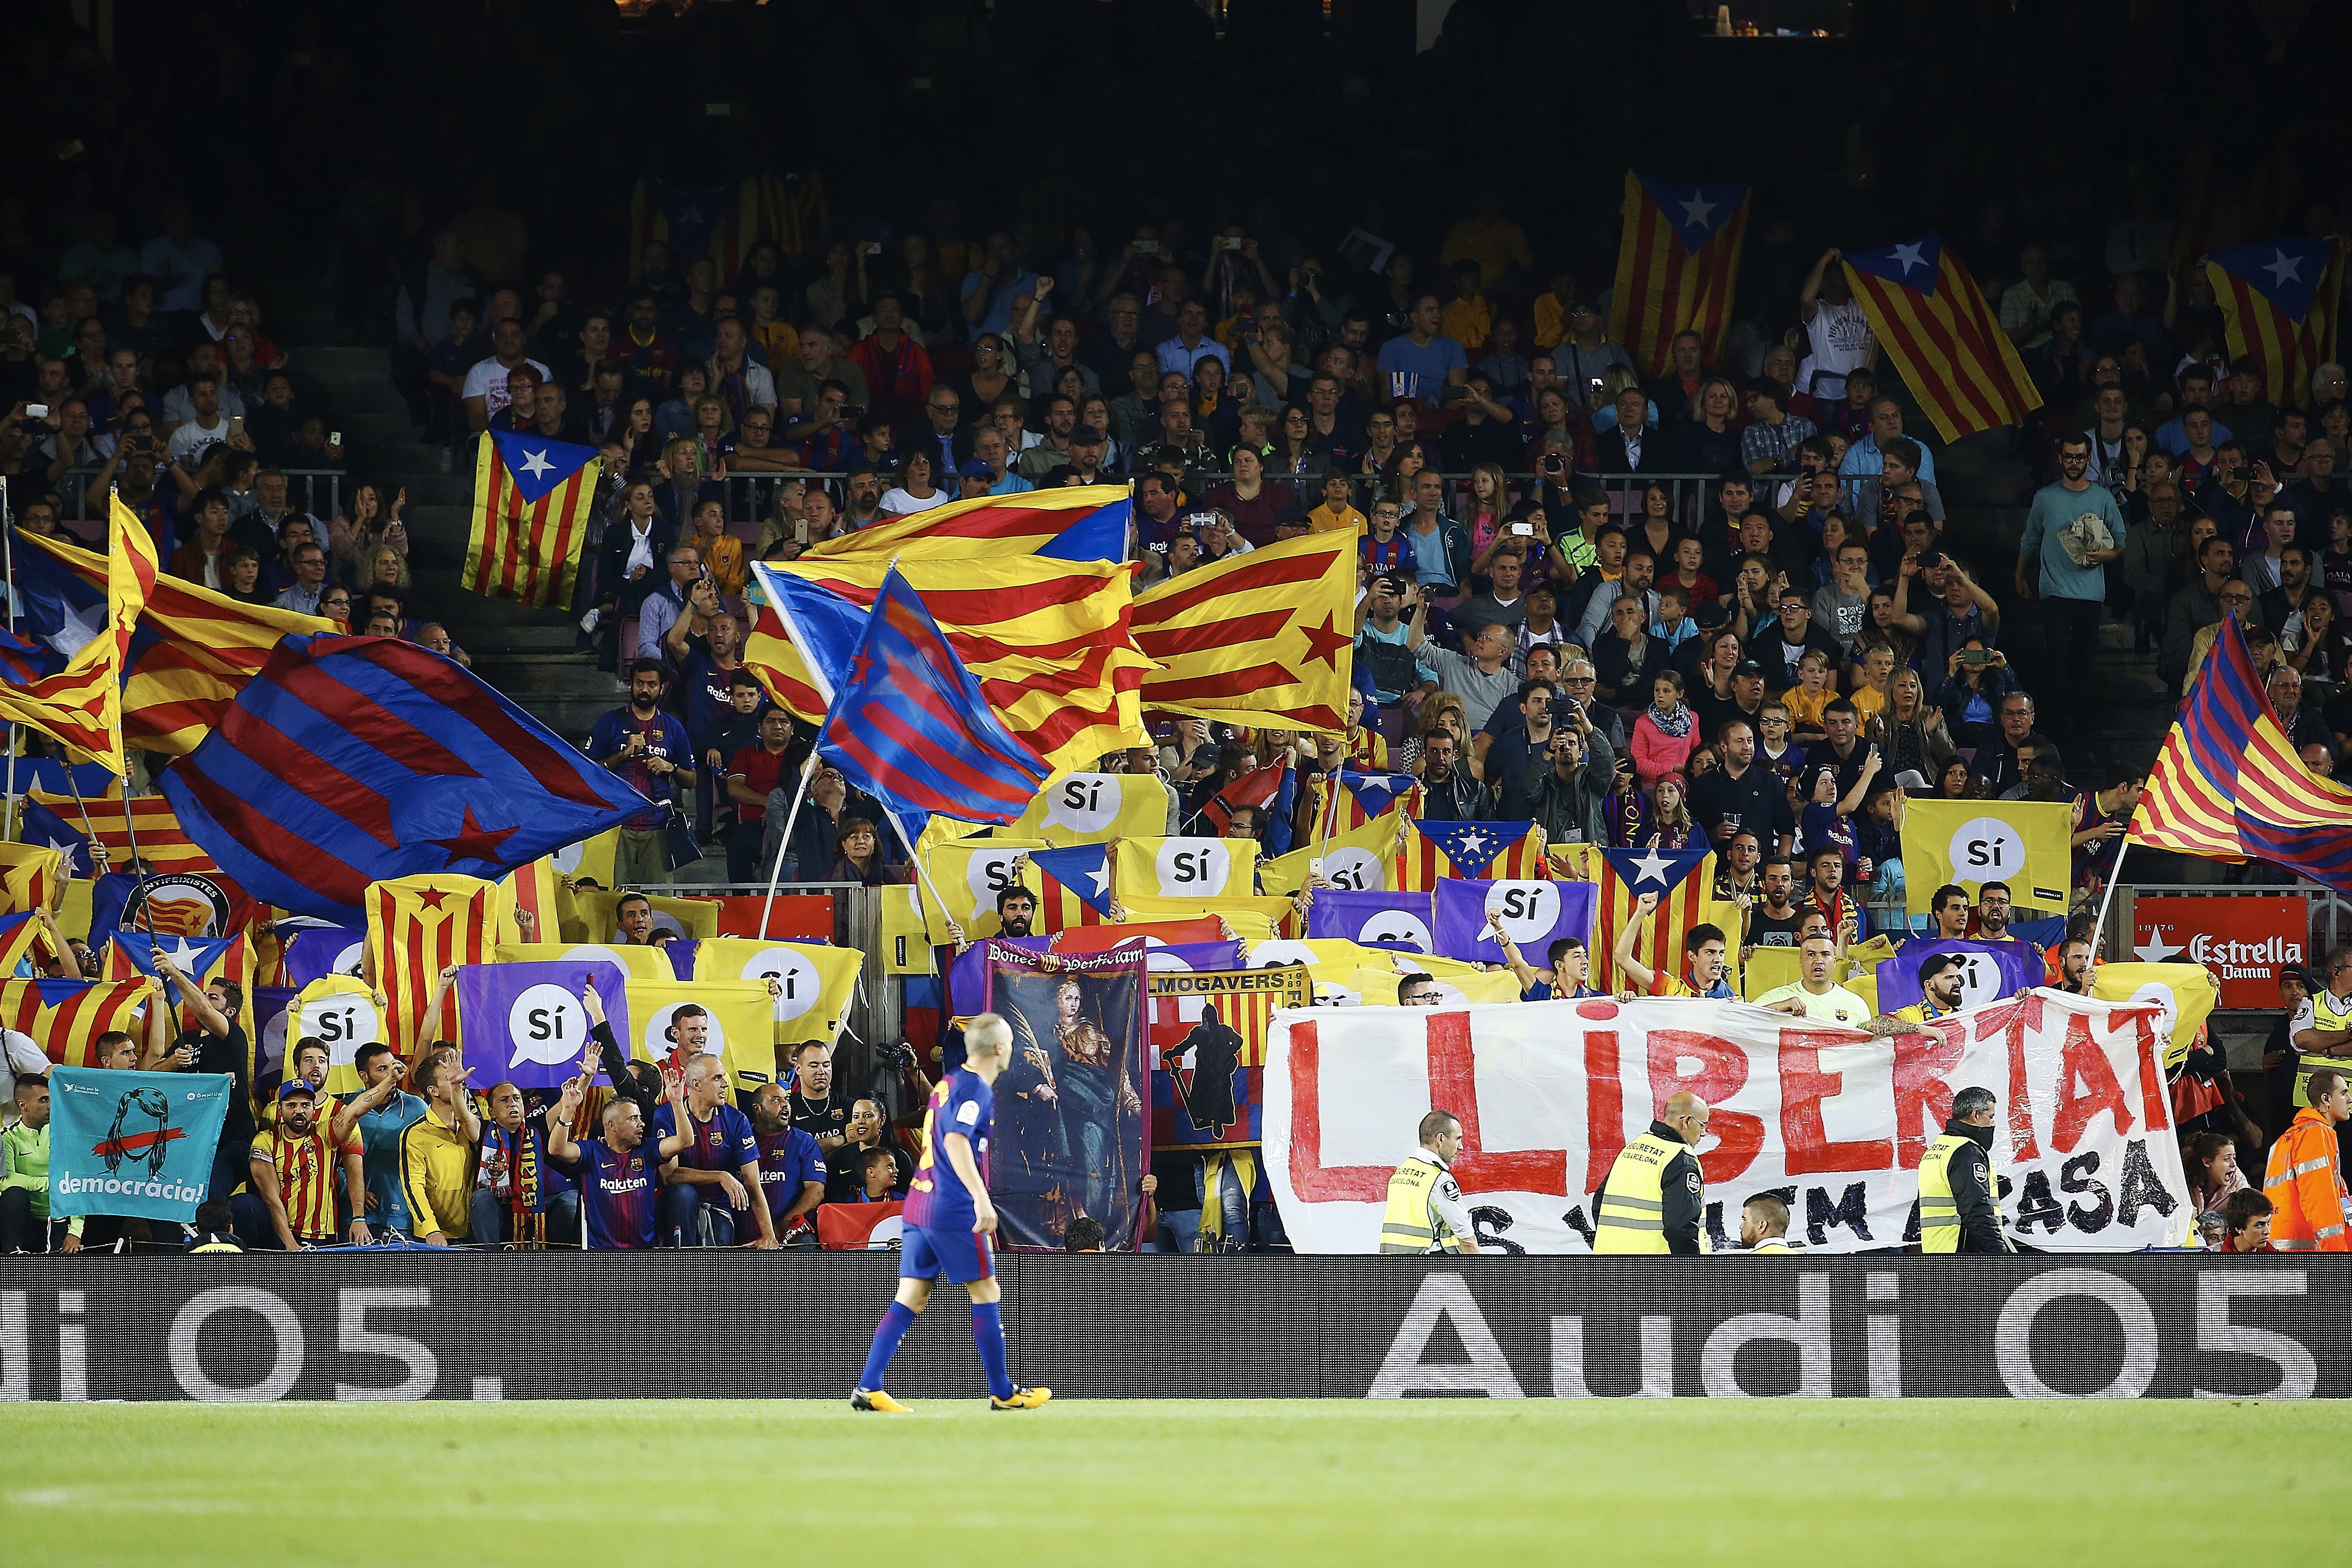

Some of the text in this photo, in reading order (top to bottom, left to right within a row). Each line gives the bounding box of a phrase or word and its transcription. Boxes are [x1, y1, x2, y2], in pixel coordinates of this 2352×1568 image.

[1062, 779, 1105, 812] Sí
[1174, 848, 1212, 883] Sí
[1967, 838, 2006, 868] Sí
[1331, 862, 1364, 891] Sí
[1503, 888, 1544, 920] Sí
[987, 943, 1037, 966] Donec
[2189, 933, 2304, 966] Estrella
[2220, 964, 2272, 980] Damm
[318, 1007, 354, 1042] Sí
[528, 1005, 567, 1040] Sí
[1626, 1142, 1665, 1157] SEGURETAT
[58, 1171, 205, 1204] democràcia!
[600, 1177, 647, 1194] Rakuten
[1367, 1271, 1900, 1399] Audi
